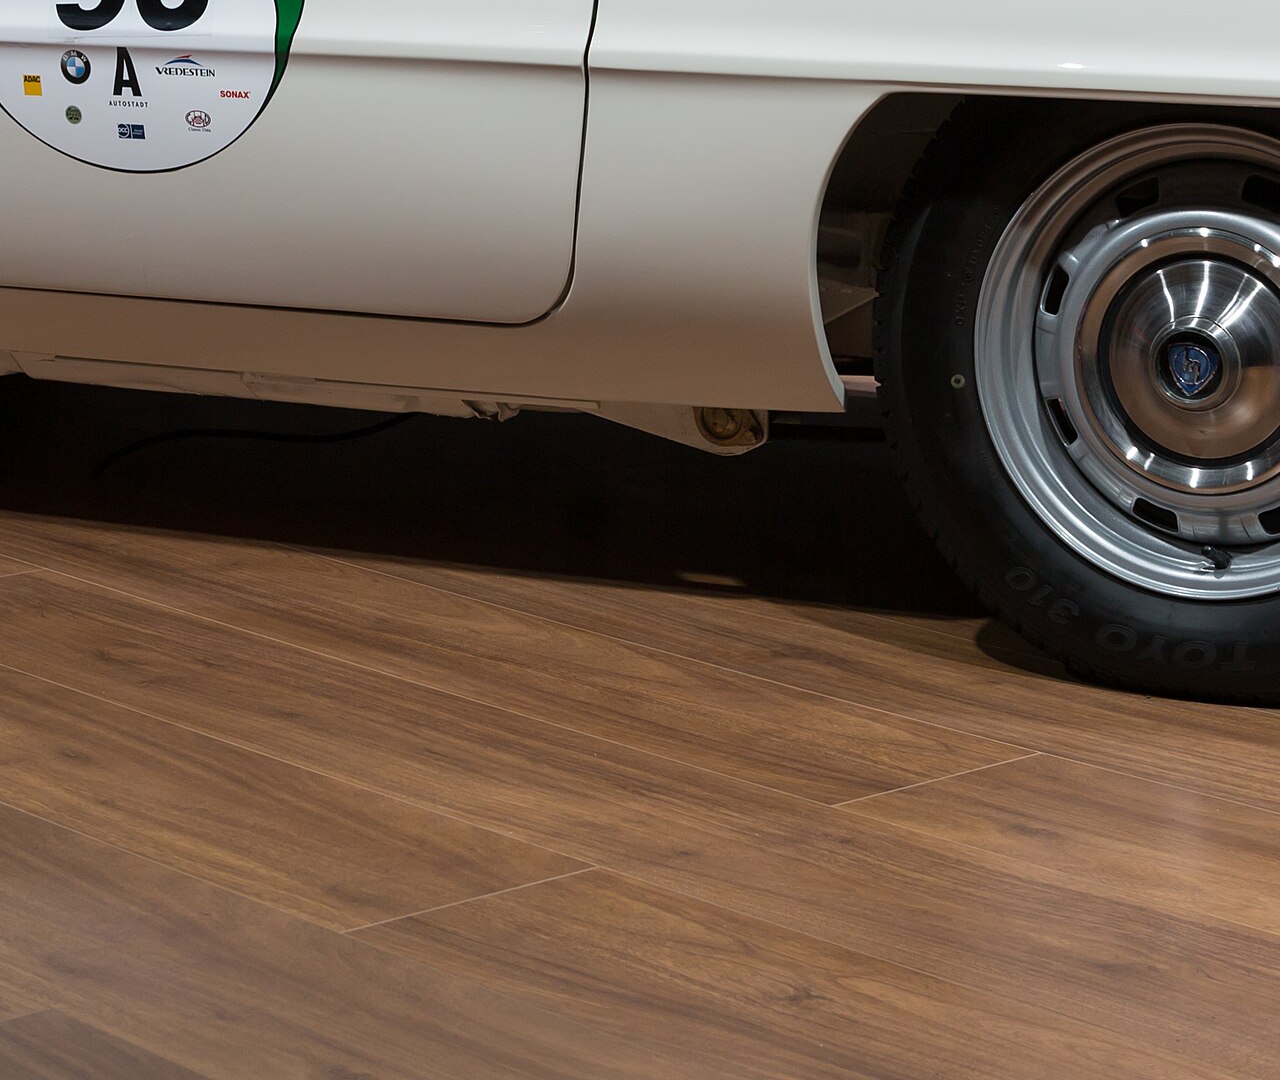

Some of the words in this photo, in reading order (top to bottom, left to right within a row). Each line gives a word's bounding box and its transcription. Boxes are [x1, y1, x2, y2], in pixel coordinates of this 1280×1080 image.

[112, 46, 143, 97] A
[154, 66, 216, 78] VREDESTEIN
[23, 75, 41, 83] ADAC
[219, 90, 250, 99] SONAX
[108, 100, 149, 108] AUTOSTADT
